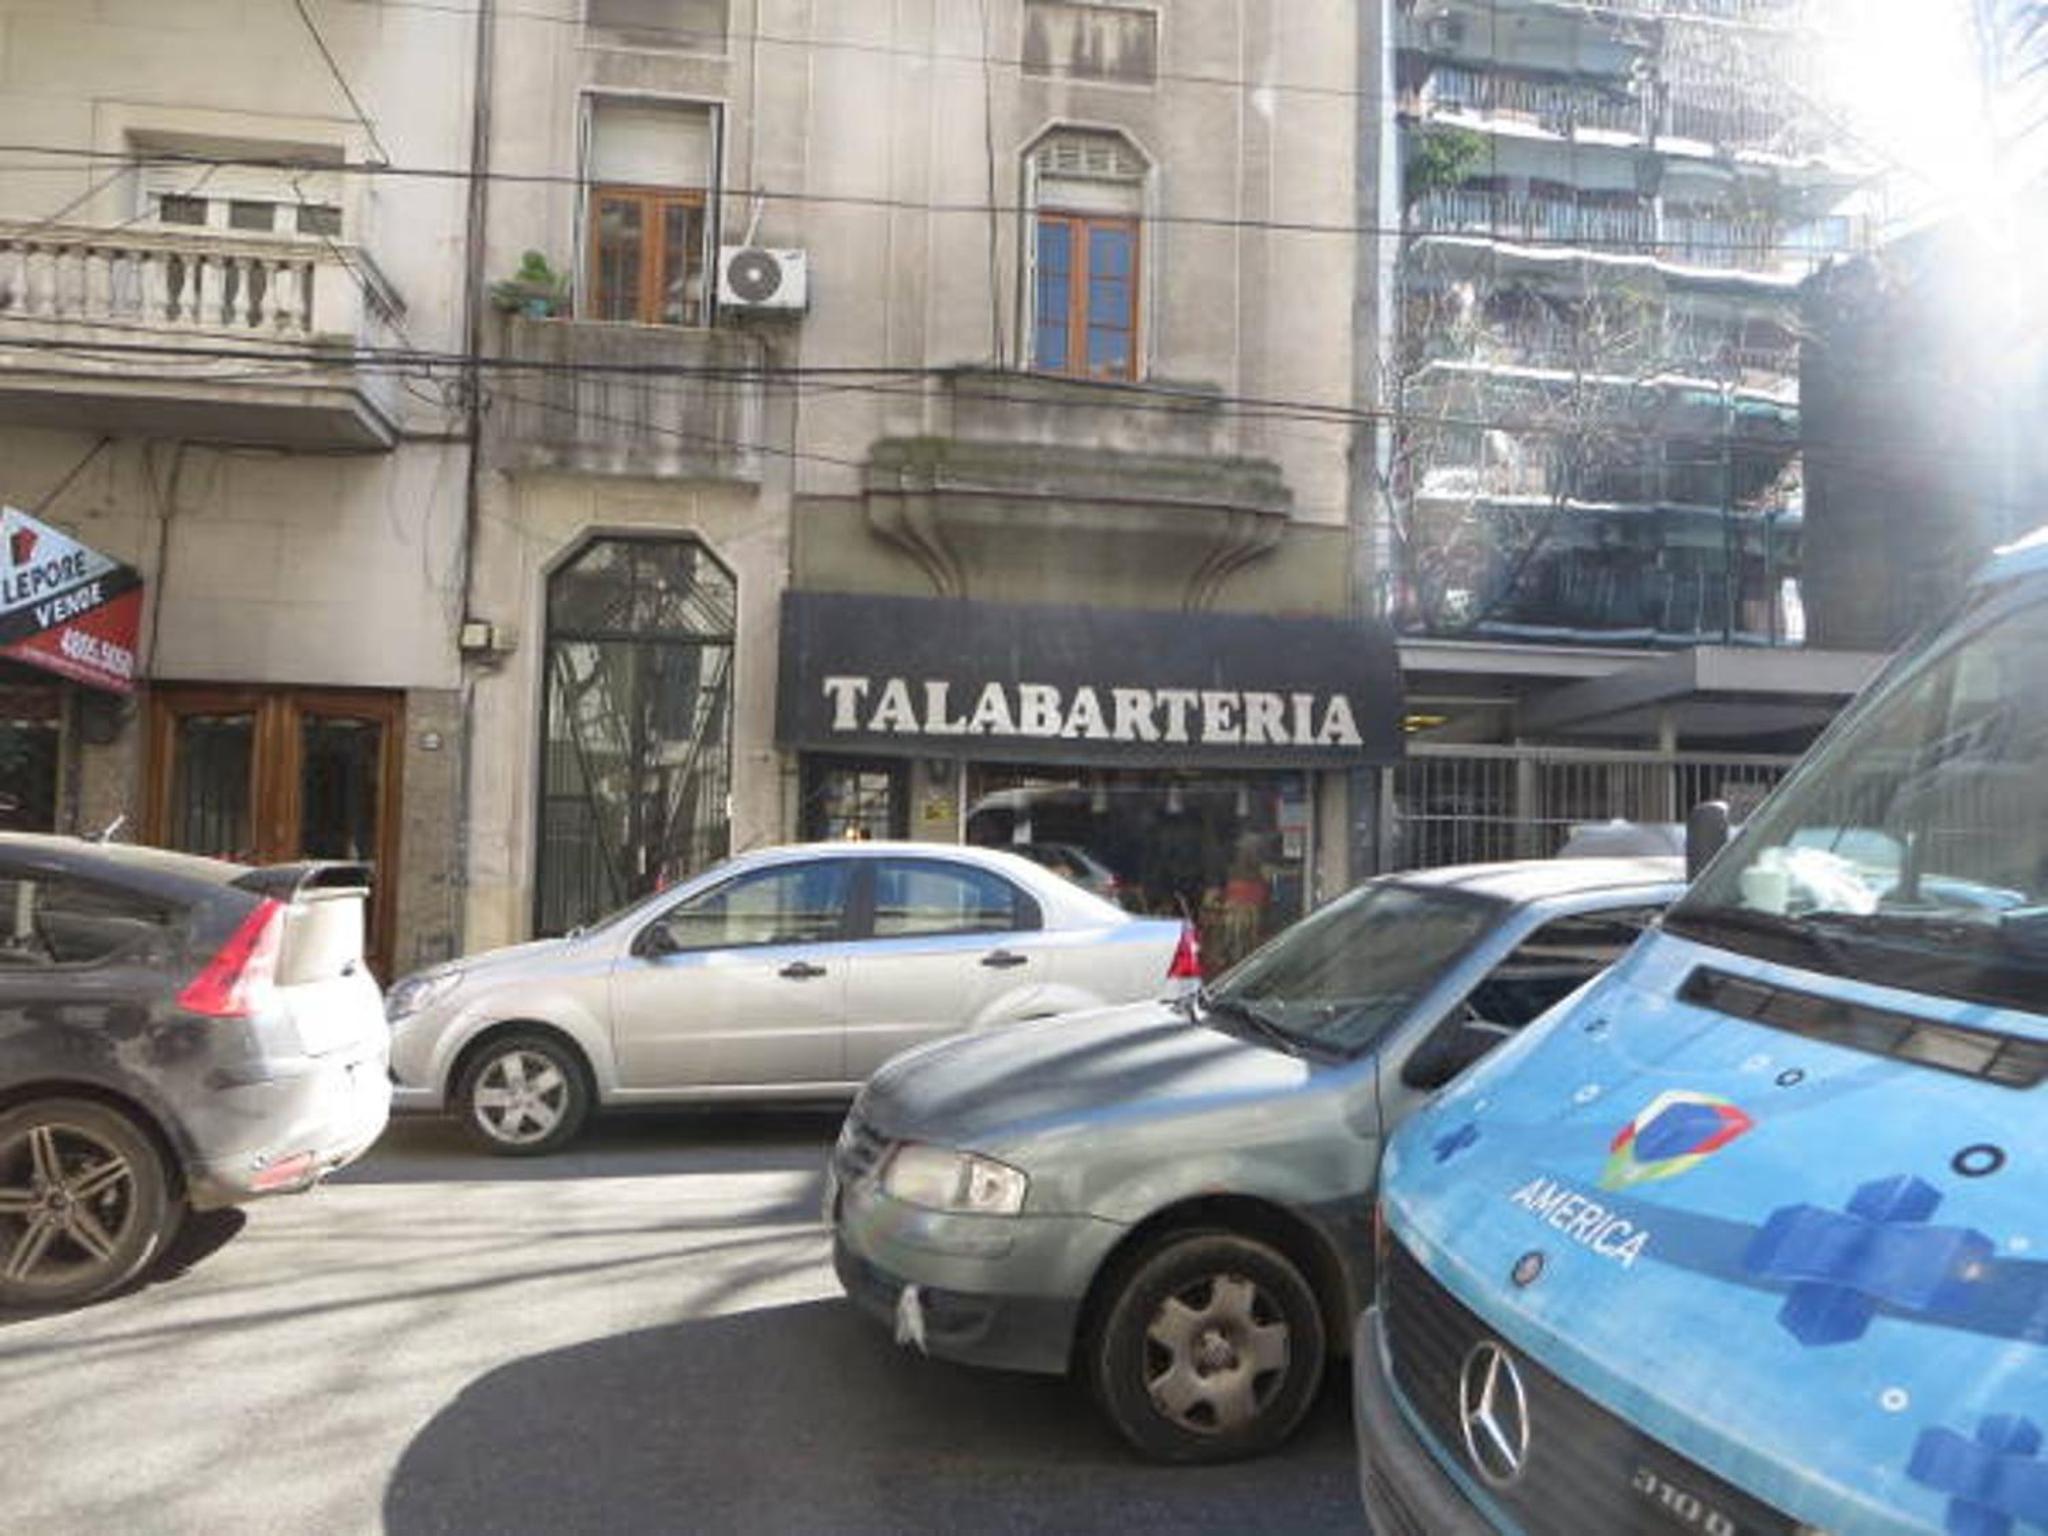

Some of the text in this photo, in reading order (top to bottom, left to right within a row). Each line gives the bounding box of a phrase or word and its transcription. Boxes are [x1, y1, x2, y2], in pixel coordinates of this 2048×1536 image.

[2, 551, 86, 603] LEPORE
[36, 583, 104, 628] VENDE
[823, 675, 1364, 747] TALABARTERIA
[1511, 1175, 1649, 1268] AMERICA
